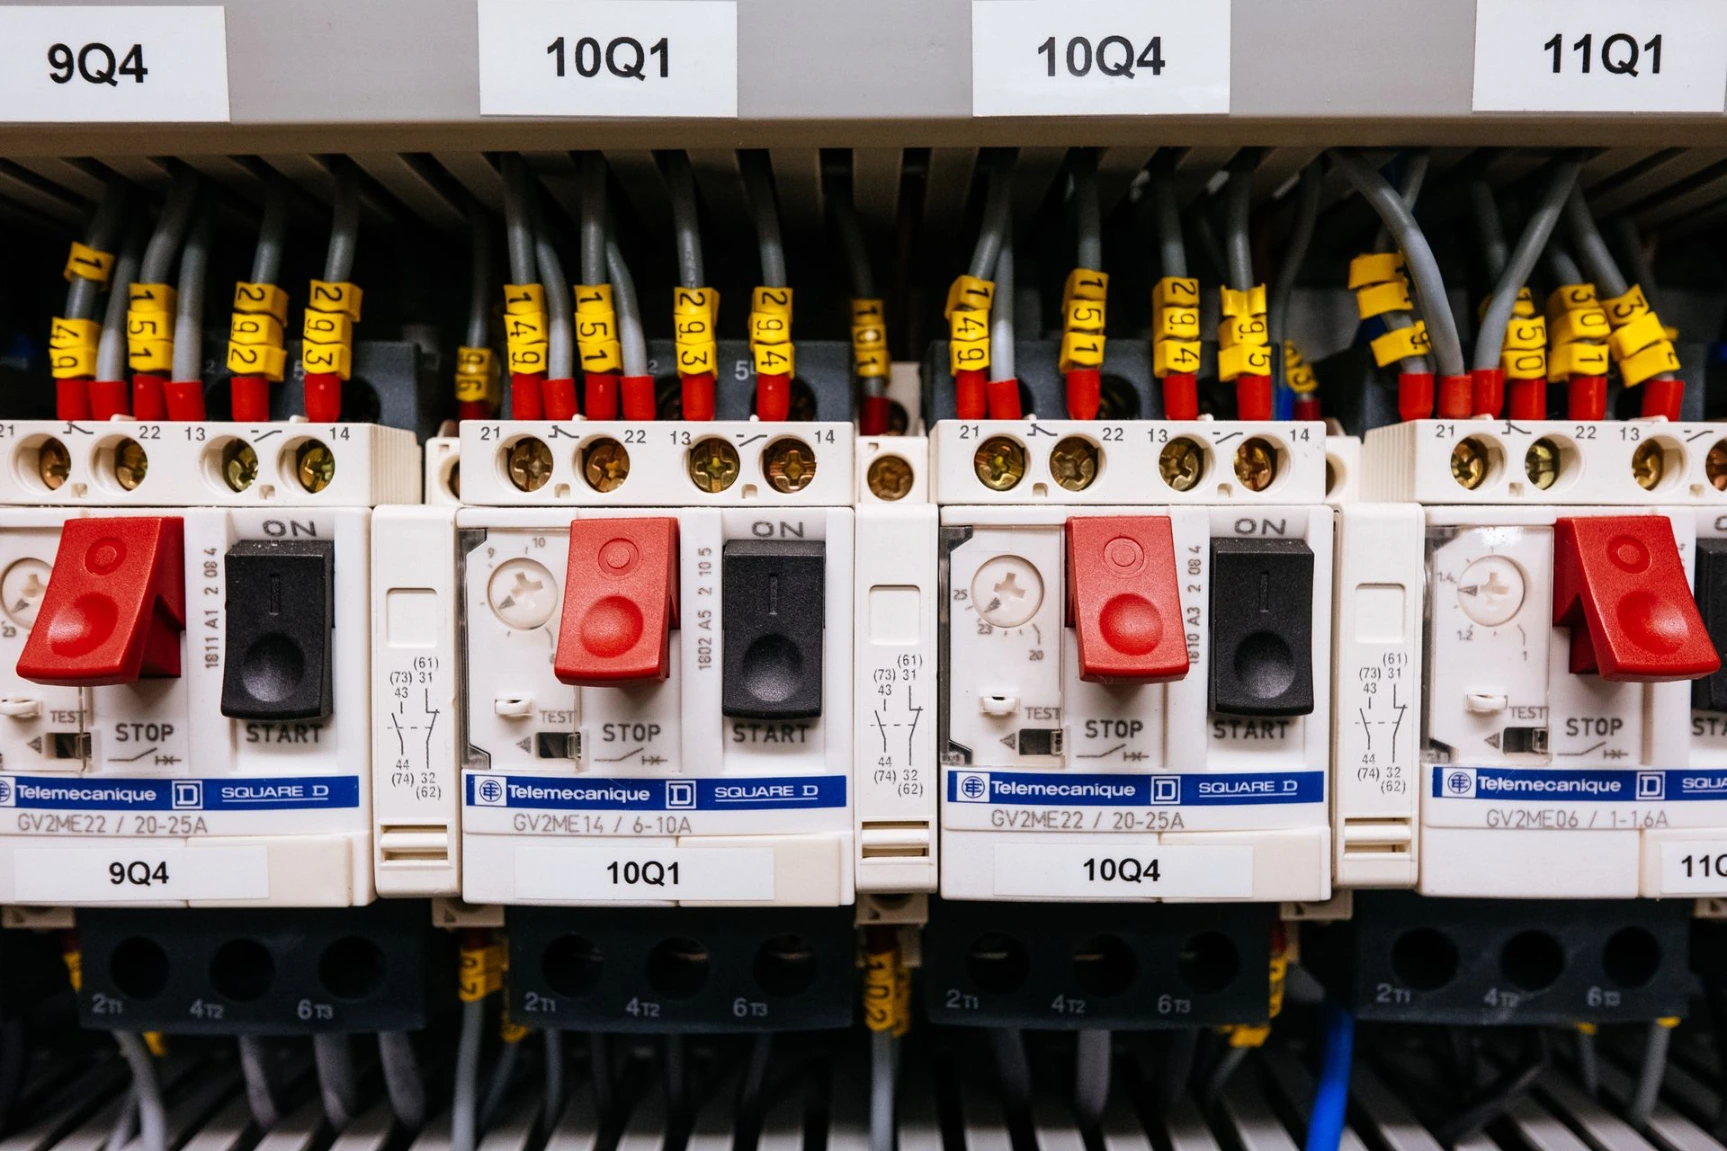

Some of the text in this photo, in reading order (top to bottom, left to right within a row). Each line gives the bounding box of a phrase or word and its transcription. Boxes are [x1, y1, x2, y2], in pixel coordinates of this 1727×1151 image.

[547, 36, 669, 81] 10Q1
[1038, 35, 1165, 80] 10Q4
[1544, 33, 1662, 78] 11Q1
[47, 43, 148, 88] 9Q4
[139, 426, 161, 440] 22
[184, 426, 206, 441] 13
[329, 427, 350, 441] 14
[480, 426, 500, 441] 21
[624, 430, 646, 444] 22
[670, 430, 691, 445] 13
[814, 429, 836, 444] 14
[959, 425, 980, 439] 21
[1102, 427, 1124, 441] 22
[1147, 428, 1168, 443] 13
[1289, 428, 1310, 442] 14
[1435, 425, 1455, 438] 21
[1575, 425, 1596, 439] 22
[1619, 427, 1640, 441] 13
[262, 520, 317, 537] ON
[751, 520, 804, 538] ON
[1234, 518, 1286, 535] ON
[953, 589, 968, 600] 25
[977, 623, 993, 635] 23
[413, 657, 439, 669] (61)
[897, 655, 923, 668] (61)
[1382, 653, 1408, 666] (61)
[390, 672, 412, 685] (73)
[419, 672, 432, 683] 31
[873, 669, 896, 683] (73)
[903, 669, 916, 681] 31
[1359, 668, 1381, 681] (73)
[1388, 667, 1401, 679] 31
[394, 687, 409, 698] 43
[878, 684, 892, 696] 43
[1363, 683, 1377, 694] 43
[50, 710, 87, 724] TEST
[539, 709, 576, 724] TEST
[1025, 706, 1061, 720] TEST
[1509, 706, 1548, 719] TEST
[115, 724, 174, 742] STOP
[246, 724, 323, 743] START
[603, 723, 661, 742] STOP
[733, 723, 810, 743] START
[1085, 720, 1143, 739] STOP
[1213, 720, 1289, 739] START
[1566, 717, 1623, 737] STOP
[1692, 717, 1727, 736] ST
[396, 759, 410, 770] 44
[878, 757, 892, 767] 44
[1362, 754, 1376, 765] 44
[421, 772, 436, 784] 32
[874, 770, 896, 784] (74)
[903, 770, 918, 781] 32
[1357, 767, 1379, 782] (74)
[1386, 767, 1401, 778] 32
[392, 773, 414, 787] (74)
[1199, 780, 1298, 794] SQUARE D
[1478, 776, 1621, 794] Telemecanique
[16, 785, 157, 803] Telemecanique
[222, 785, 329, 798] SQUARE D
[416, 786, 442, 800] (62)
[508, 784, 650, 803] Telemecanique
[715, 785, 818, 798] SQUARE D
[898, 784, 923, 797] (62)
[991, 781, 1135, 799] Telemecanique
[1380, 781, 1406, 795] (62)
[18, 813, 106, 833] GV2ME22
[135, 815, 208, 834] 20-25A
[513, 813, 604, 833] GV2ME14
[633, 815, 691, 833] 6-10A
[991, 809, 1083, 829] GV2ME22
[1113, 811, 1184, 829] 20-25A
[1486, 809, 1578, 828] GV2ME06
[109, 861, 169, 886] 9Q4
[607, 860, 679, 887] 10Q1
[1083, 858, 1160, 883] 10Q4
